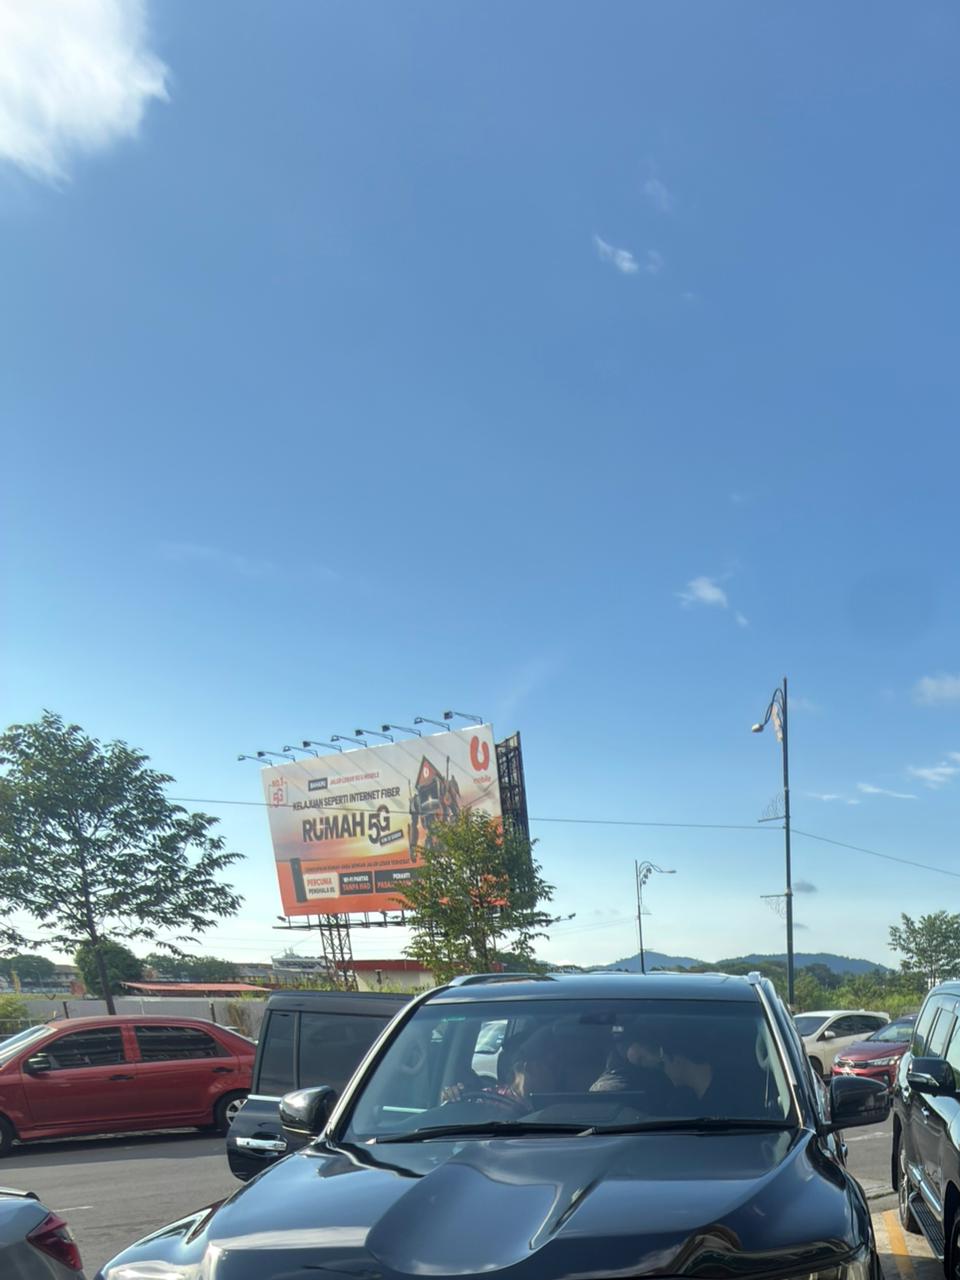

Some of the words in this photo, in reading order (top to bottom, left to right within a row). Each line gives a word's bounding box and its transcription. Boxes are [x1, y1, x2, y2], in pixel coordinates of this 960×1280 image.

[292, 798, 324, 812] KELAJUAN
[324, 794, 349, 807] SEPERTI
[349, 789, 382, 803] INTERNET
[381, 786, 400, 798] FIBER
[302, 812, 365, 843] RUMAH
[368, 804, 391, 844] 5G
